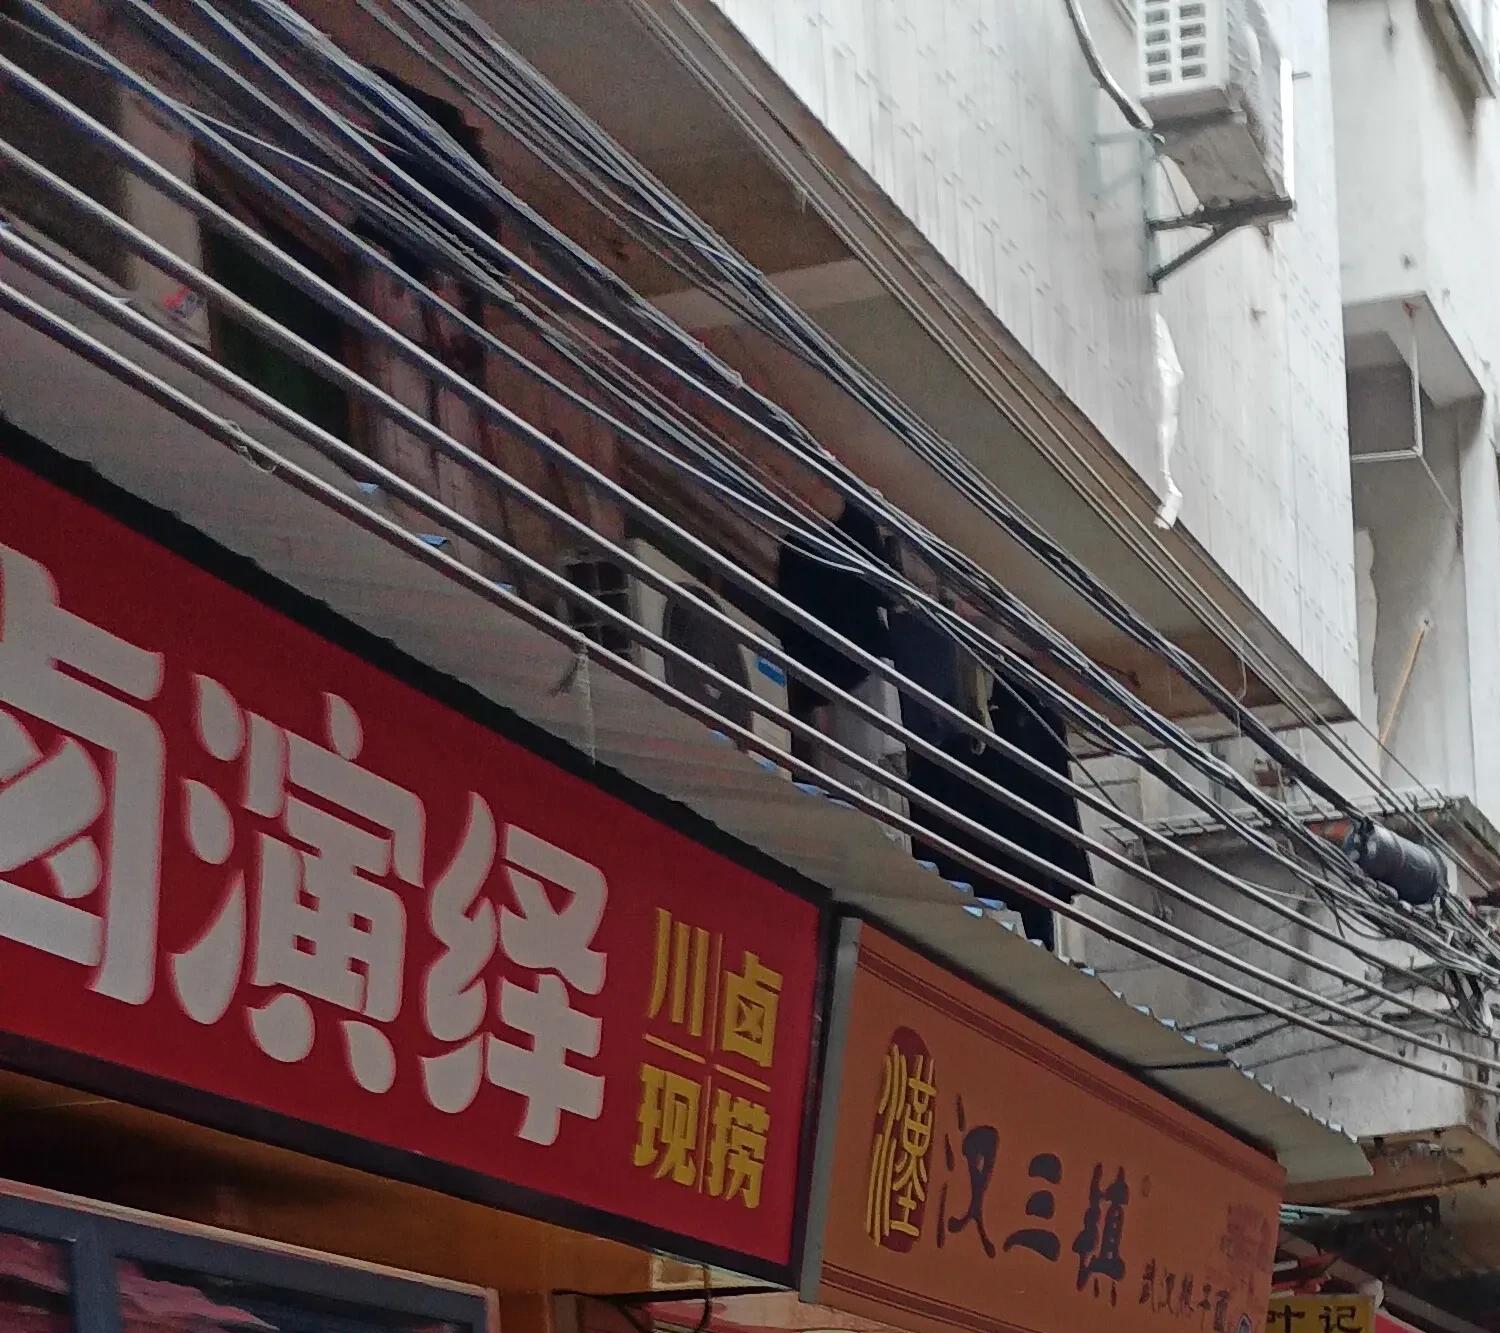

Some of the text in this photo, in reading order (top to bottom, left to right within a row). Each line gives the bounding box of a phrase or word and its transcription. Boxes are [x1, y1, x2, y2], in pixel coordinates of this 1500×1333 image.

[648, 906, 784, 1067] 川卤
[633, 1063, 771, 1208] 现捞
[936, 1094, 1130, 1306] 汉三镇
